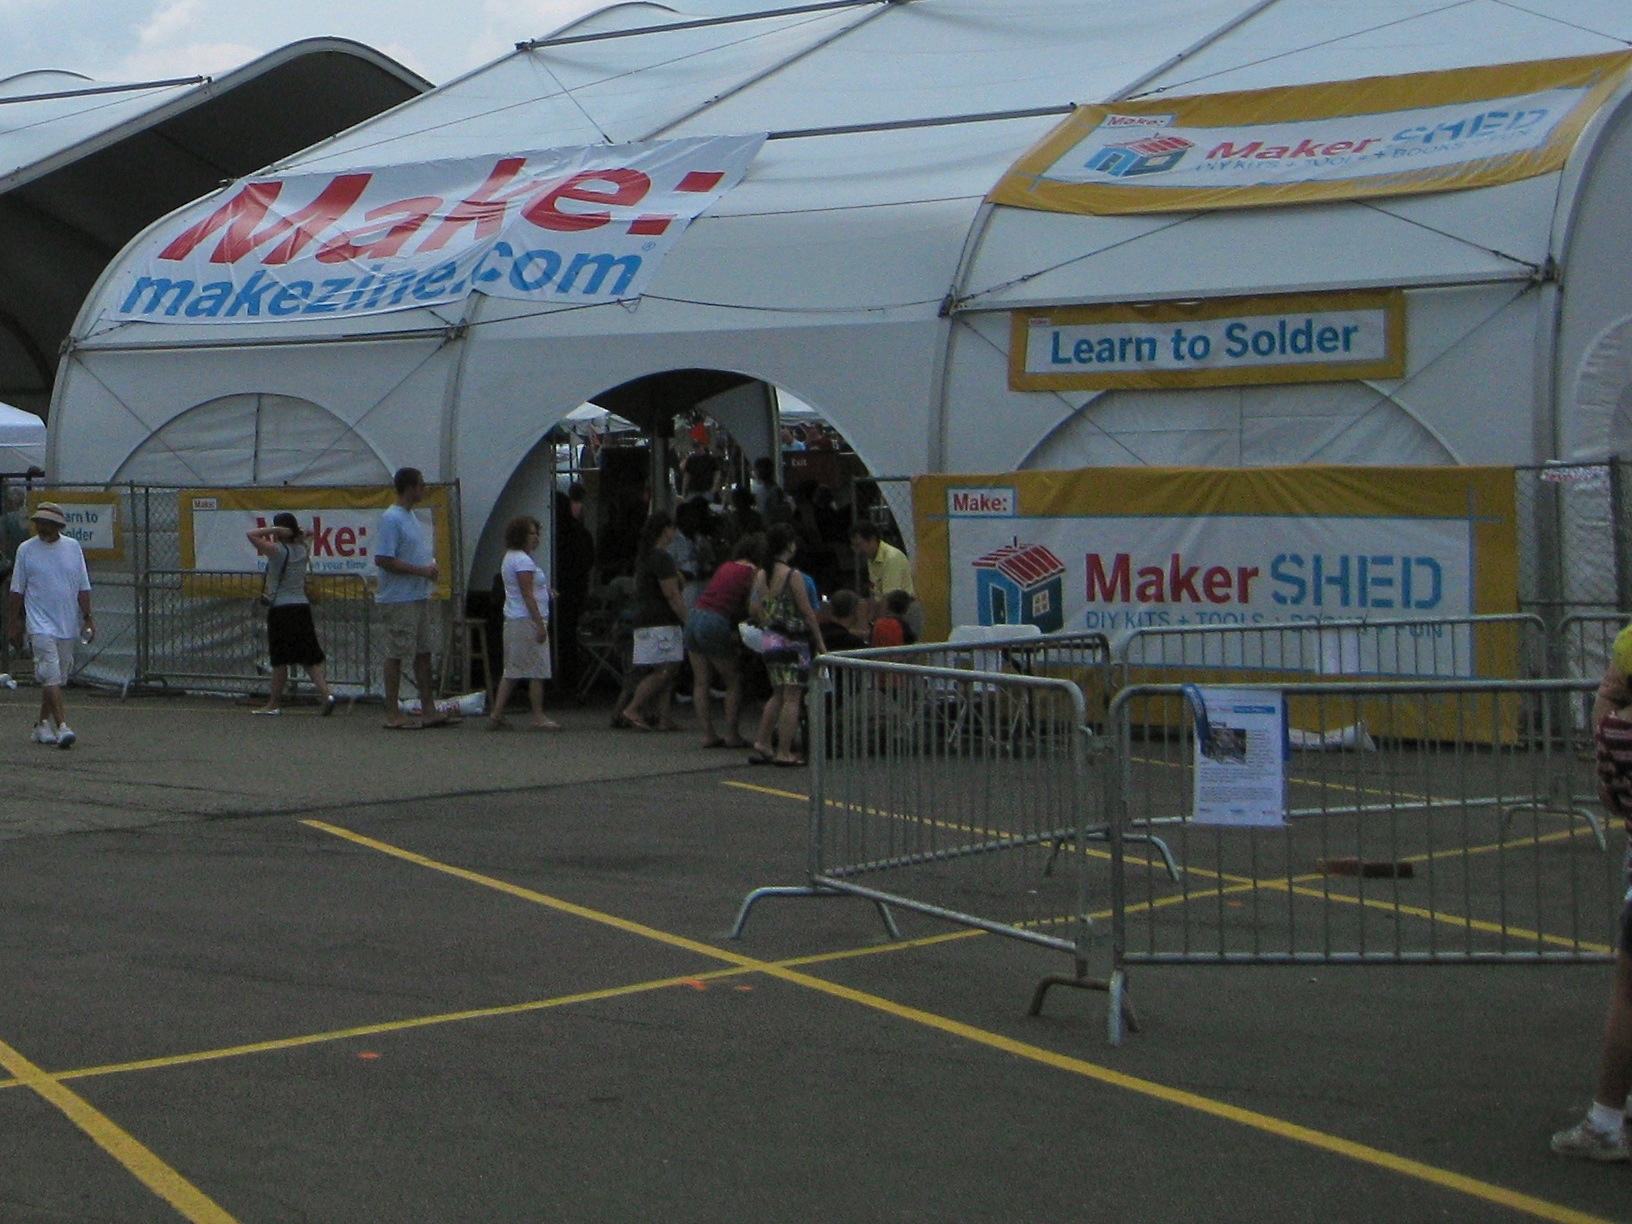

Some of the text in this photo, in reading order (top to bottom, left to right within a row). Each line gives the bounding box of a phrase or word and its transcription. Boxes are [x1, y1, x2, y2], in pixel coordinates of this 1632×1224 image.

[1205, 137, 1381, 161] Maker
[157, 157, 726, 266] Make:
[119, 240, 644, 318] makezine.com
[1051, 318, 1358, 365] Learn to Solder
[194, 499, 215, 510] Make:
[952, 493, 1009, 513] Make:
[64, 512, 83, 523] arn
[85, 510, 99, 523] to
[65, 527, 94, 542] older
[1085, 552, 1443, 610] Maker SHED
[1086, 610, 1119, 630] DIY
[1125, 610, 1170, 630] KITS
